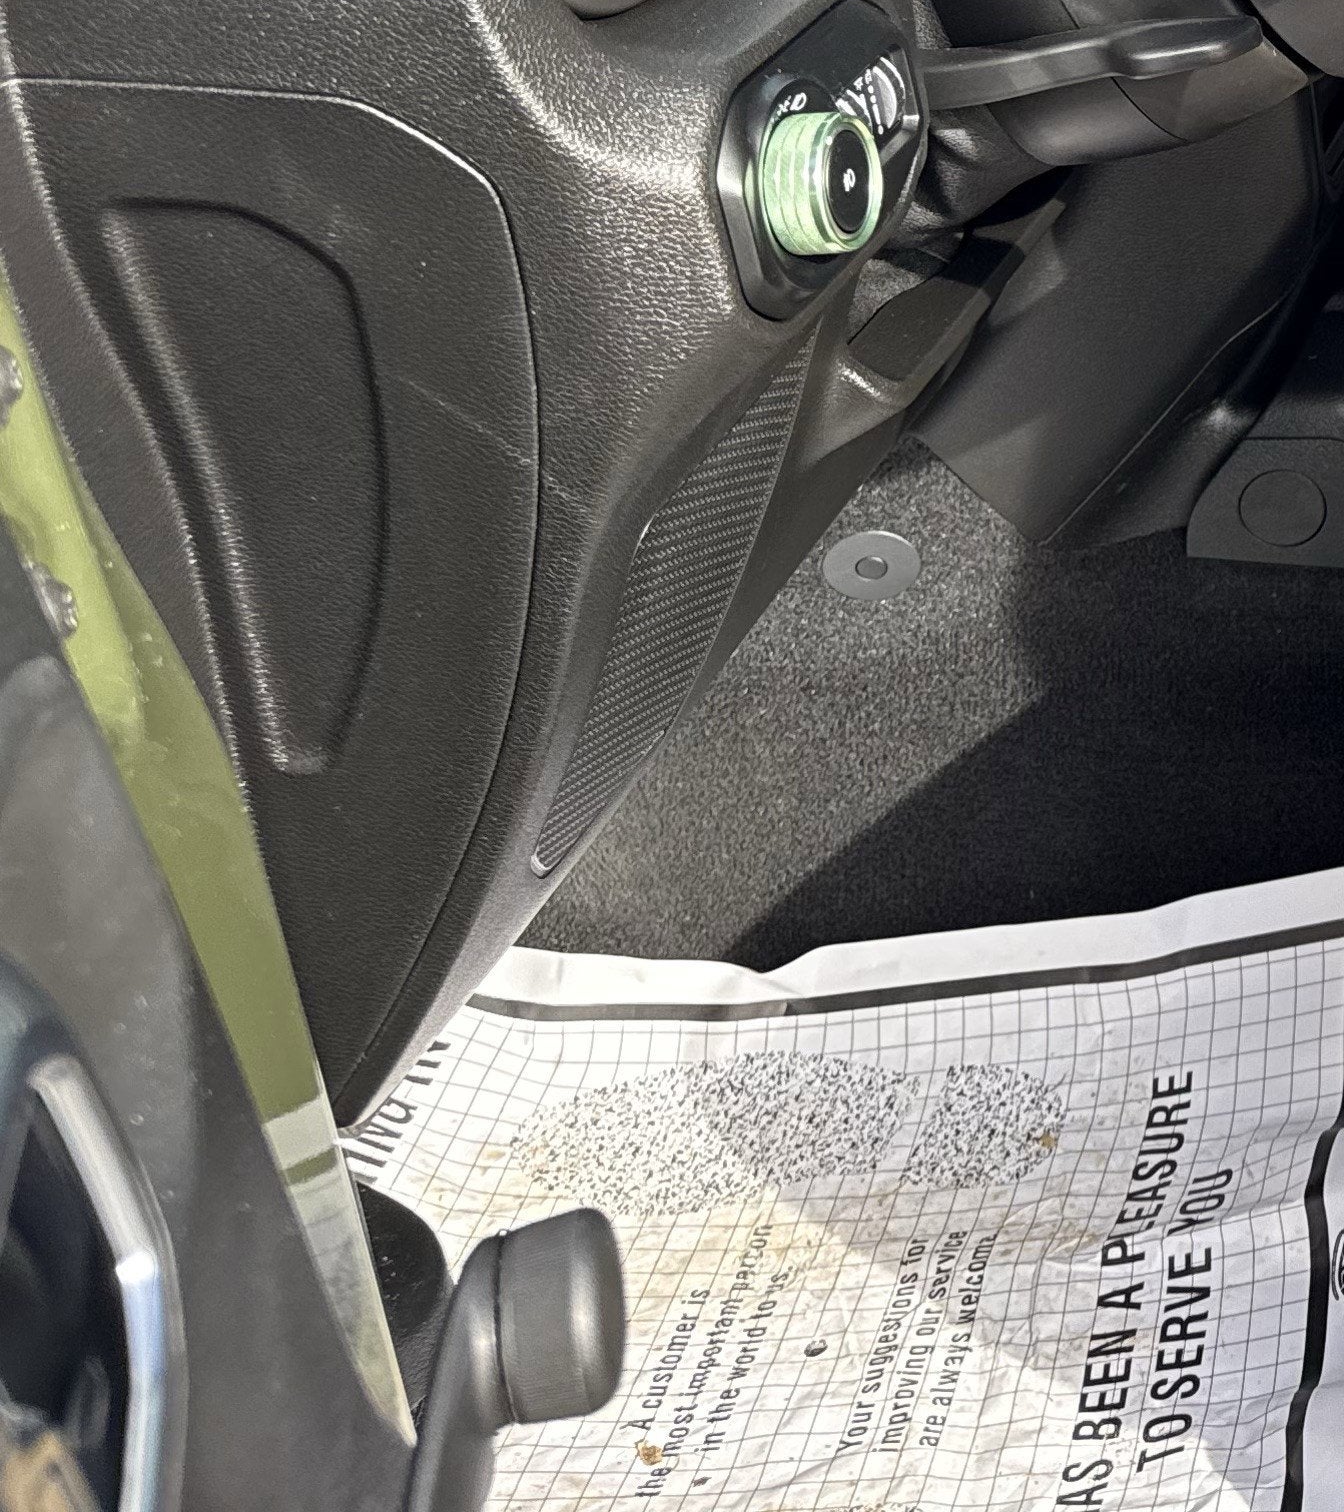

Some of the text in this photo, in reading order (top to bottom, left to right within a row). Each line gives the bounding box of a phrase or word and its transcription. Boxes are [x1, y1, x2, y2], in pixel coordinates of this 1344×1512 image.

[619, 1288, 710, 1429] A customer is
[680, 1296, 744, 1396] important
[695, 1265, 794, 1452] in the world to us.
[836, 1237, 929, 1451] Your suggestions for
[873, 1230, 967, 1452] improving our service
[1055, 1069, 1193, 1511] AS BEEN A PLEASURE
[1135, 1166, 1234, 1472] TO SERVE YOU
[663, 1403, 698, 1456] most
[919, 1414, 946, 1446] are
[930, 1332, 972, 1405] always
[635, 1466, 672, 1496] the
